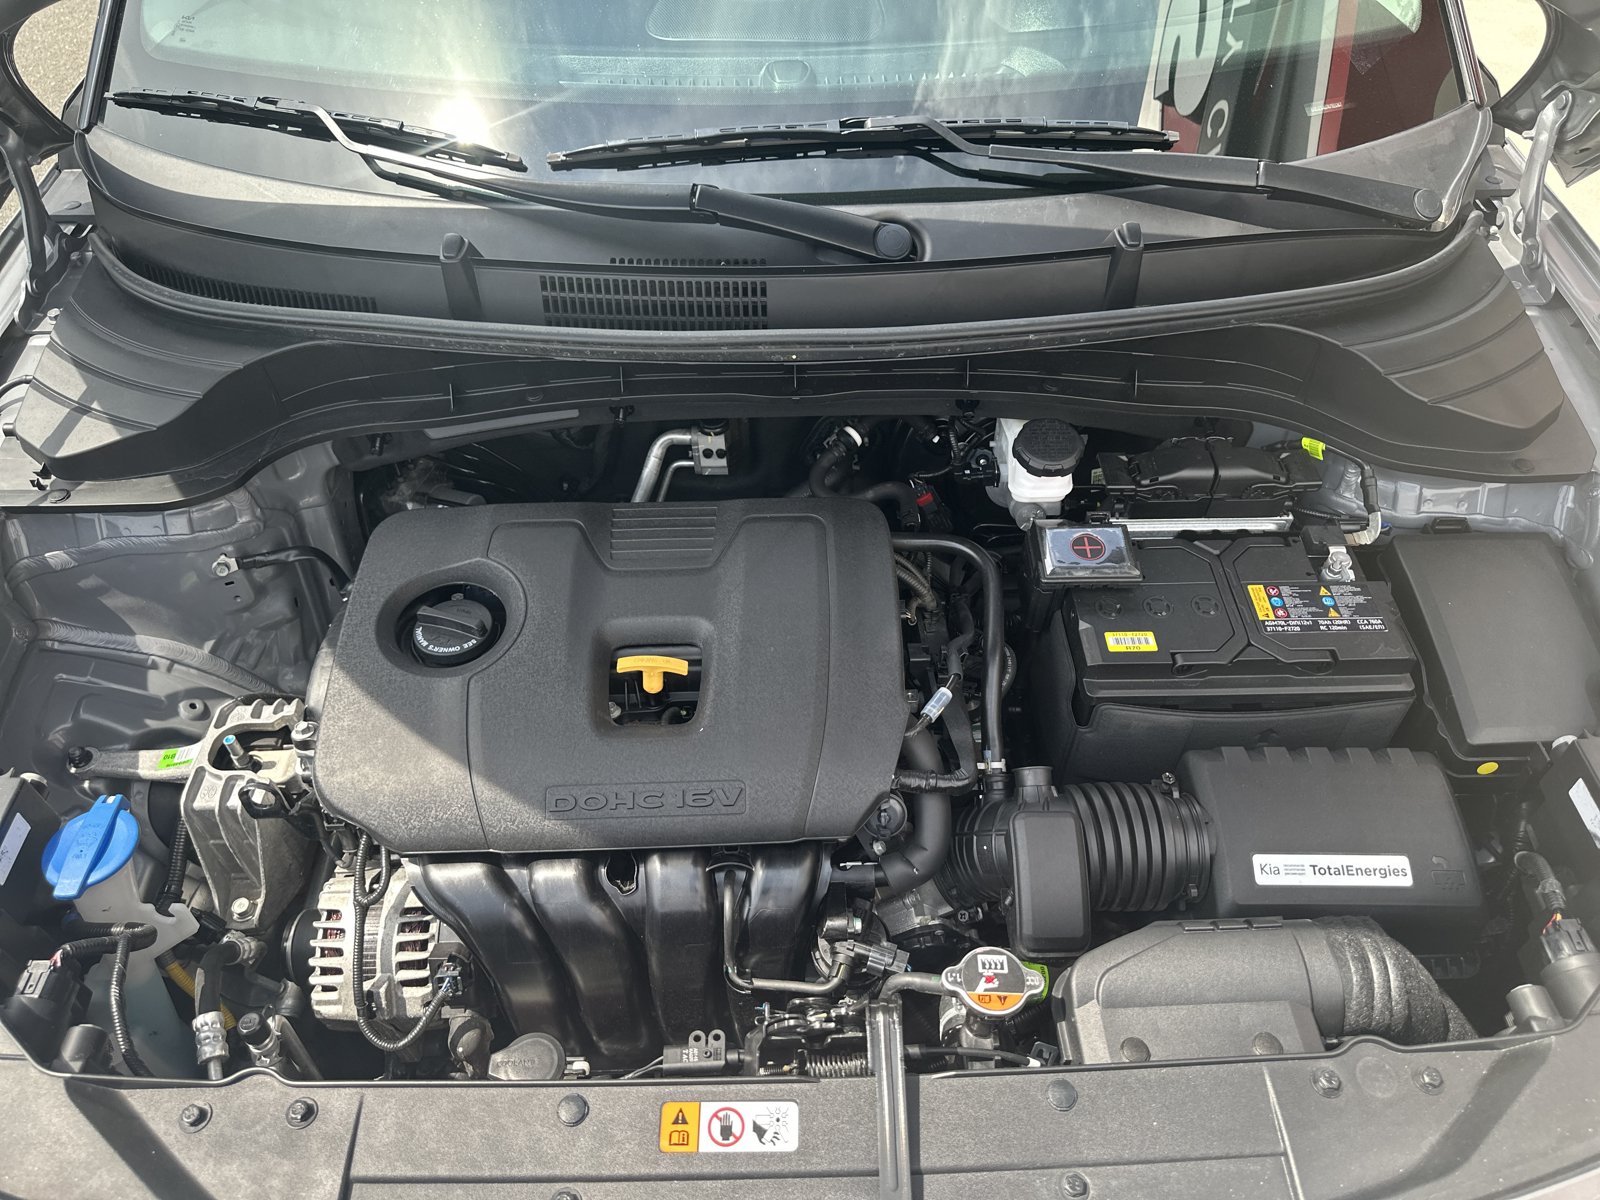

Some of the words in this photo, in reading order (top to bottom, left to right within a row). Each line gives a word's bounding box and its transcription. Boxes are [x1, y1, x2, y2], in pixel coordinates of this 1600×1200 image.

[415, 626, 429, 646] MANUAL
[462, 638, 477, 649] SEE
[549, 791, 665, 813] DOHC
[675, 787, 744, 809] 16V
[1259, 863, 1281, 876] Kia
[1309, 864, 1408, 879] TotalEnergies
